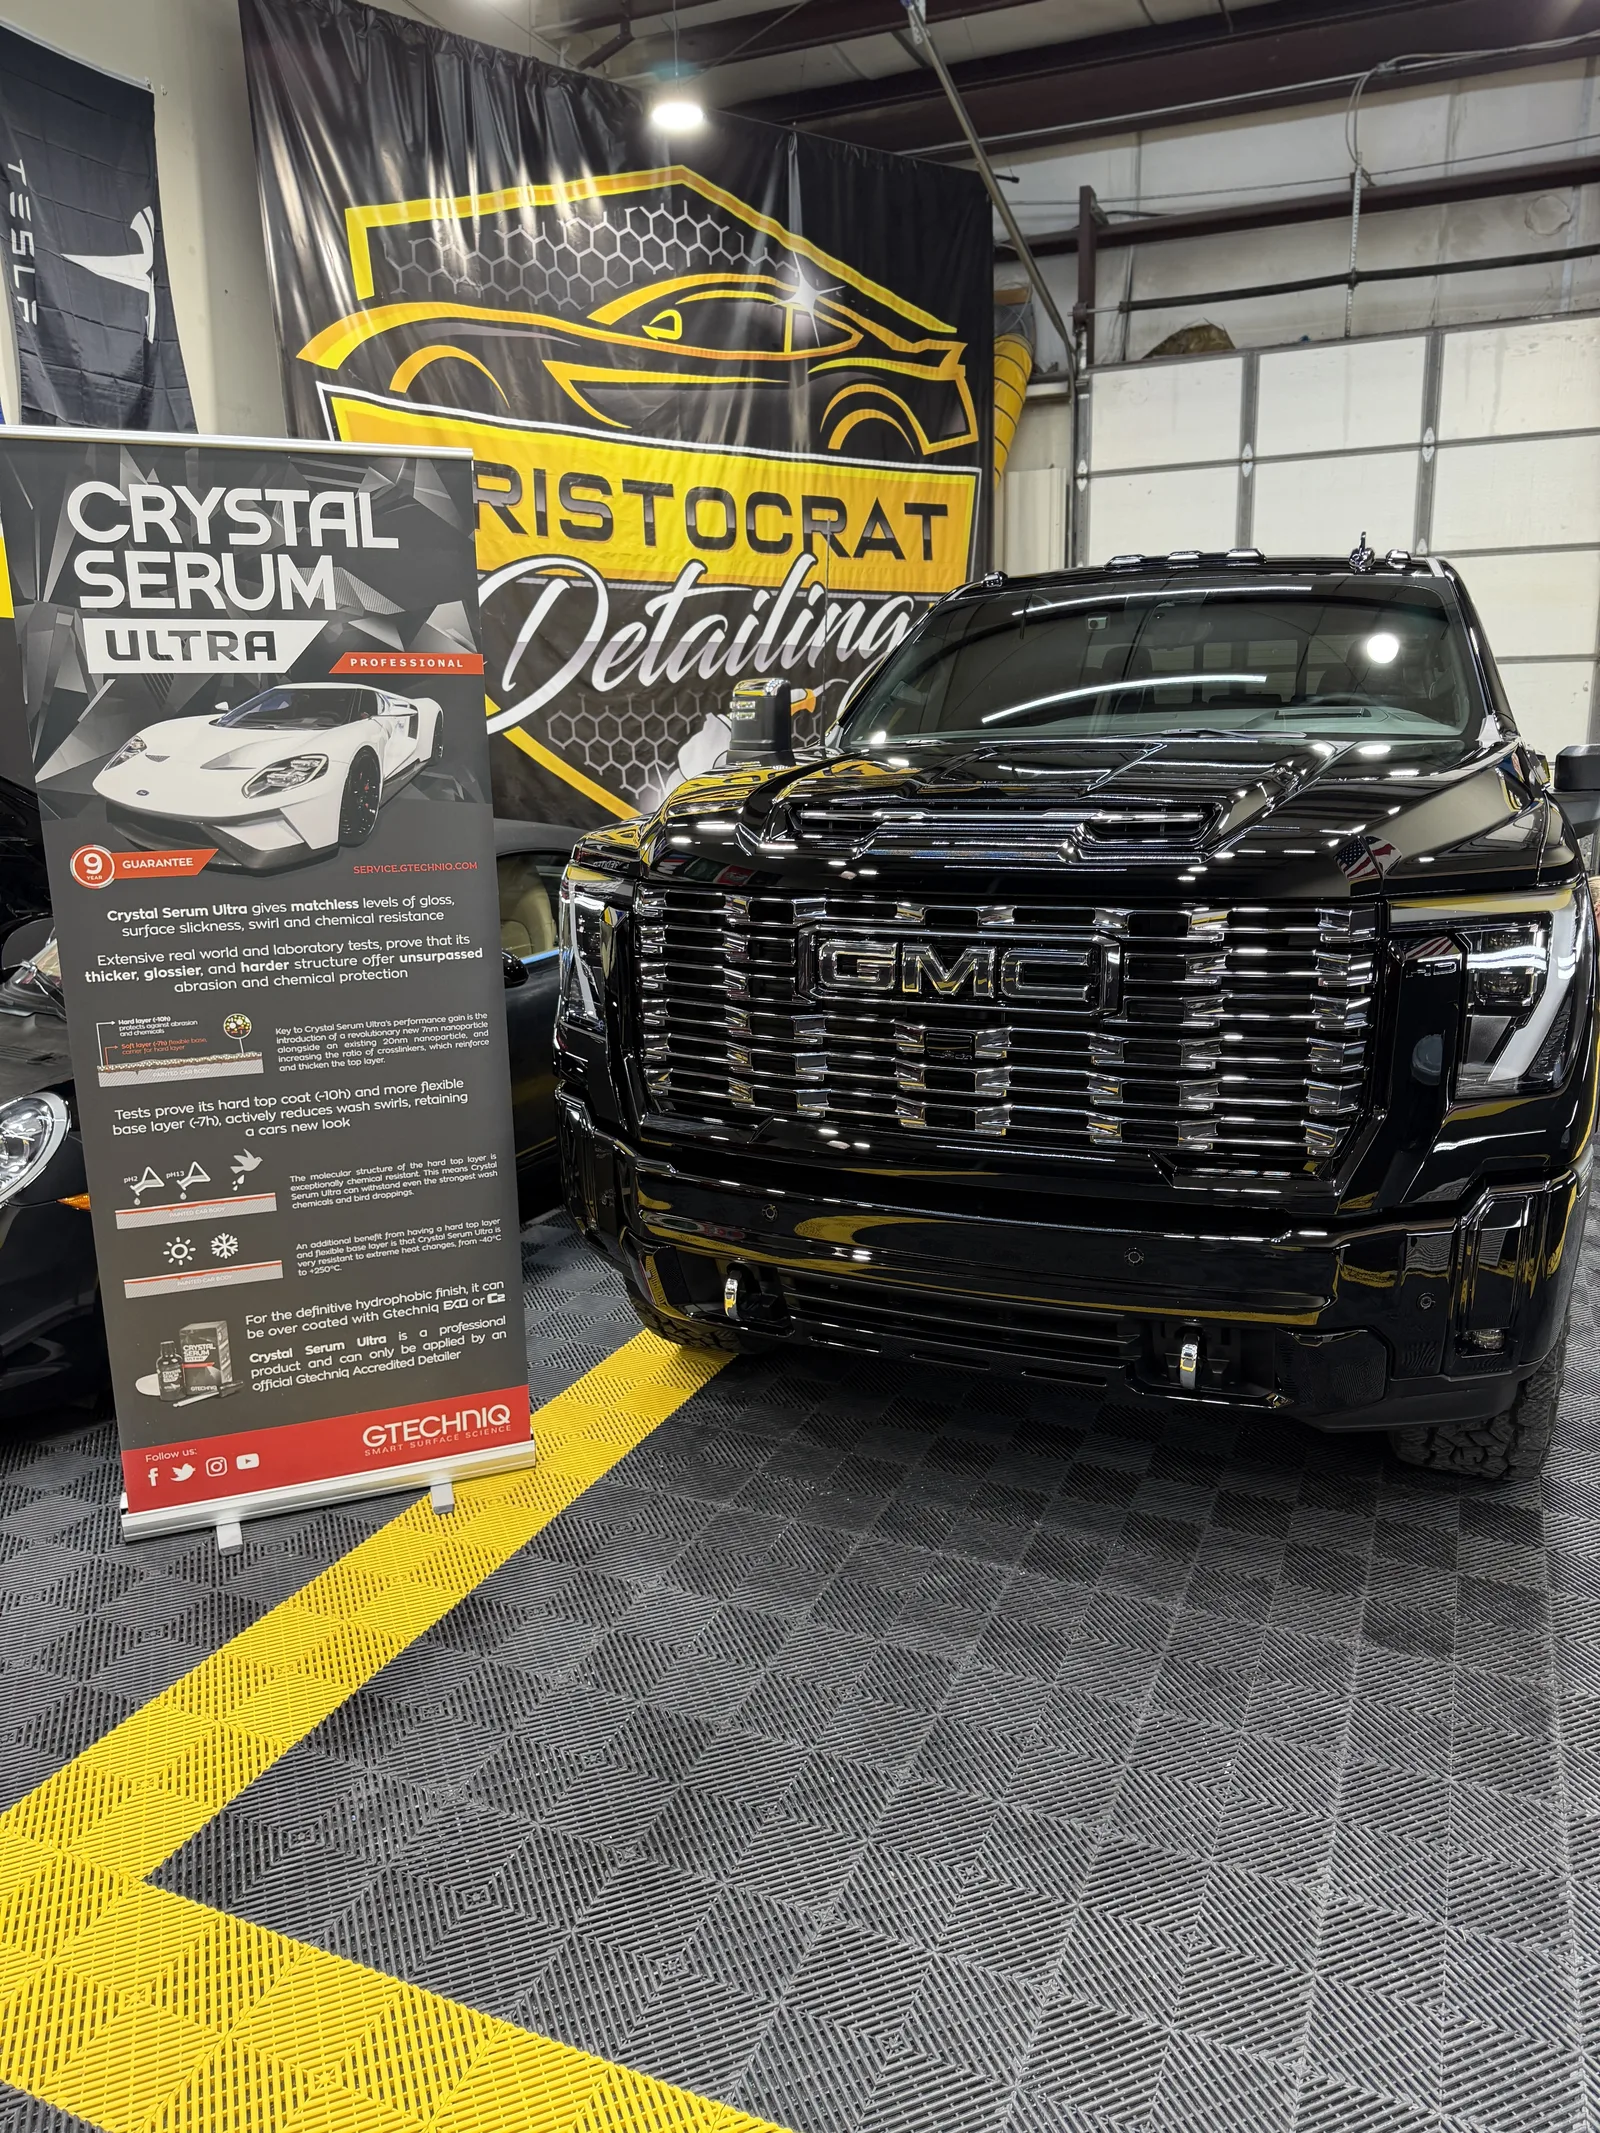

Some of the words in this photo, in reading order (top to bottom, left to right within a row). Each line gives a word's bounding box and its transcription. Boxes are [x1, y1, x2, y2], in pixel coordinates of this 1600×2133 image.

[8, 159, 37, 325] TESLA
[67, 481, 399, 549] CRYSTAL
[473, 460, 948, 561] RISTOCRAT
[74, 550, 336, 611] SERUM
[105, 629, 277, 661] ULTRA
[479, 554, 915, 733] Detailing
[350, 657, 463, 668] PROFESSIONAL
[83, 853, 103, 875] 9
[122, 858, 194, 870] GUARANTEE
[106, 908, 158, 924] Crystal
[162, 908, 208, 918] Serum
[212, 905, 248, 916] Ultra
[251, 903, 287, 917] gives
[290, 900, 359, 912] matchless
[362, 897, 398, 909] levels
[402, 896, 416, 910] of
[419, 895, 455, 909] gloss,
[121, 924, 175, 938] surface
[179, 921, 244, 933] slickness,
[248, 918, 279, 930] swirl
[283, 916, 310, 928] and
[314, 913, 374, 926] chemical
[378, 911, 444, 923] resistance
[84, 970, 140, 982] thicker,
[143, 966, 204, 982] glossier,
[208, 963, 236, 975] and
[240, 960, 290, 973] harder
[294, 956, 358, 970] structure
[362, 954, 395, 968] offer
[399, 948, 483, 964] unsurpassed
[97, 952, 164, 966] Extensive
[168, 950, 196, 962] real
[199, 947, 238, 960] world
[242, 945, 269, 957] and
[273, 942, 344, 956] laboratory
[347, 939, 382, 951] tests,
[386, 939, 422, 952] prove
[426, 934, 452, 946] that
[456, 934, 470, 945] its
[174, 979, 237, 993] abrasion
[241, 976, 269, 988] and
[273, 972, 335, 986] chemical
[339, 968, 408, 985] protection
[818, 940, 1094, 1002] GMC
[275, 1028, 292, 1036] Key
[293, 1026, 303, 1034] to
[304, 1024, 335, 1034] Crystal
[365, 1020, 392, 1028] Ultra's
[393, 1017, 446, 1028] performance
[447, 1014, 466, 1024] gain
[474, 1012, 488, 1020] the
[276, 1034, 326, 1044] introduction
[328, 1032, 337, 1042] of
[347, 1029, 400, 1038] revolutionary
[422, 1025, 439, 1033] 7nm
[440, 1021, 488, 1032] nanoparticle
[276, 1043, 320, 1054] alongside
[344, 1039, 377, 1048] existing
[382, 1037, 408, 1045] 20nm
[413, 1032, 468, 1043] nanoparticle,
[472, 1030, 489, 1038] and
[112, 1124, 147, 1135] base
[150, 1120, 185, 1133] layer
[225, 1109, 276, 1124] actively
[280, 1106, 333, 1119] reduces
[336, 1099, 370, 1113] wash
[373, 1096, 411, 1110] swirls,
[414, 1091, 468, 1105] retaining
[114, 1107, 151, 1120] Tests
[154, 1106, 194, 1120] prove
[198, 1101, 214, 1113] its
[218, 1097, 250, 1111] hard
[253, 1096, 277, 1109] top
[280, 1092, 311, 1105] coat
[354, 1085, 380, 1098] and
[383, 1085, 417, 1095] more
[420, 1078, 464, 1095] flexible
[258, 1126, 287, 1135] cars
[290, 1123, 318, 1132] new
[322, 1116, 350, 1129] look
[291, 1175, 306, 1183] The
[310, 1170, 352, 1180] molecular
[355, 1166, 393, 1175] structure
[396, 1163, 406, 1172] of
[409, 1161, 423, 1169] the
[426, 1158, 446, 1167] hard
[449, 1157, 464, 1166] top
[467, 1155, 486, 1164] layer
[295, 1242, 308, 1250] An
[310, 1236, 352, 1248] additional
[353, 1232, 382, 1242] benefit
[384, 1231, 405, 1240] from
[406, 1227, 434, 1236] having
[444, 1222, 463, 1231] hard
[465, 1221, 479, 1229] top
[481, 1219, 500, 1228] layer
[245, 1314, 268, 1325] For
[270, 1309, 292, 1322] the
[295, 1301, 352, 1320] definitive
[355, 1289, 432, 1312] hydrophobic
[435, 1284, 469, 1301] finish,
[471, 1281, 479, 1293] it
[482, 1282, 504, 1291] can
[246, 1327, 264, 1339] be
[267, 1325, 298, 1336] over
[301, 1314, 348, 1331] coated
[351, 1310, 379, 1324] with
[382, 1302, 439, 1319] Gtechniq
[471, 1298, 485, 1306] or
[249, 1346, 293, 1364] Crystal
[304, 1342, 345, 1355] Serum
[356, 1334, 387, 1347] Ultra
[398, 1330, 408, 1341] is
[419, 1330, 428, 1338] a
[439, 1314, 506, 1338] professional
[250, 1359, 301, 1380] product
[307, 1354, 332, 1368] and
[339, 1353, 362, 1363] can
[368, 1346, 394, 1359] only
[400, 1343, 416, 1354] be
[422, 1334, 465, 1353] applied
[471, 1332, 486, 1345] by
[491, 1331, 506, 1340] an
[252, 1374, 293, 1392] official
[295, 1366, 350, 1383] Gtechniq
[352, 1355, 415, 1375] Accredited
[417, 1350, 461, 1365] Detailer
[362, 1403, 511, 1448] GTECHNIQ
[364, 1444, 403, 1456] SMART
[409, 1434, 459, 1448] SURFACE
[465, 1426, 511, 1439] SCIENCE
[145, 1451, 179, 1463] Follow
[182, 1448, 197, 1457] us:
